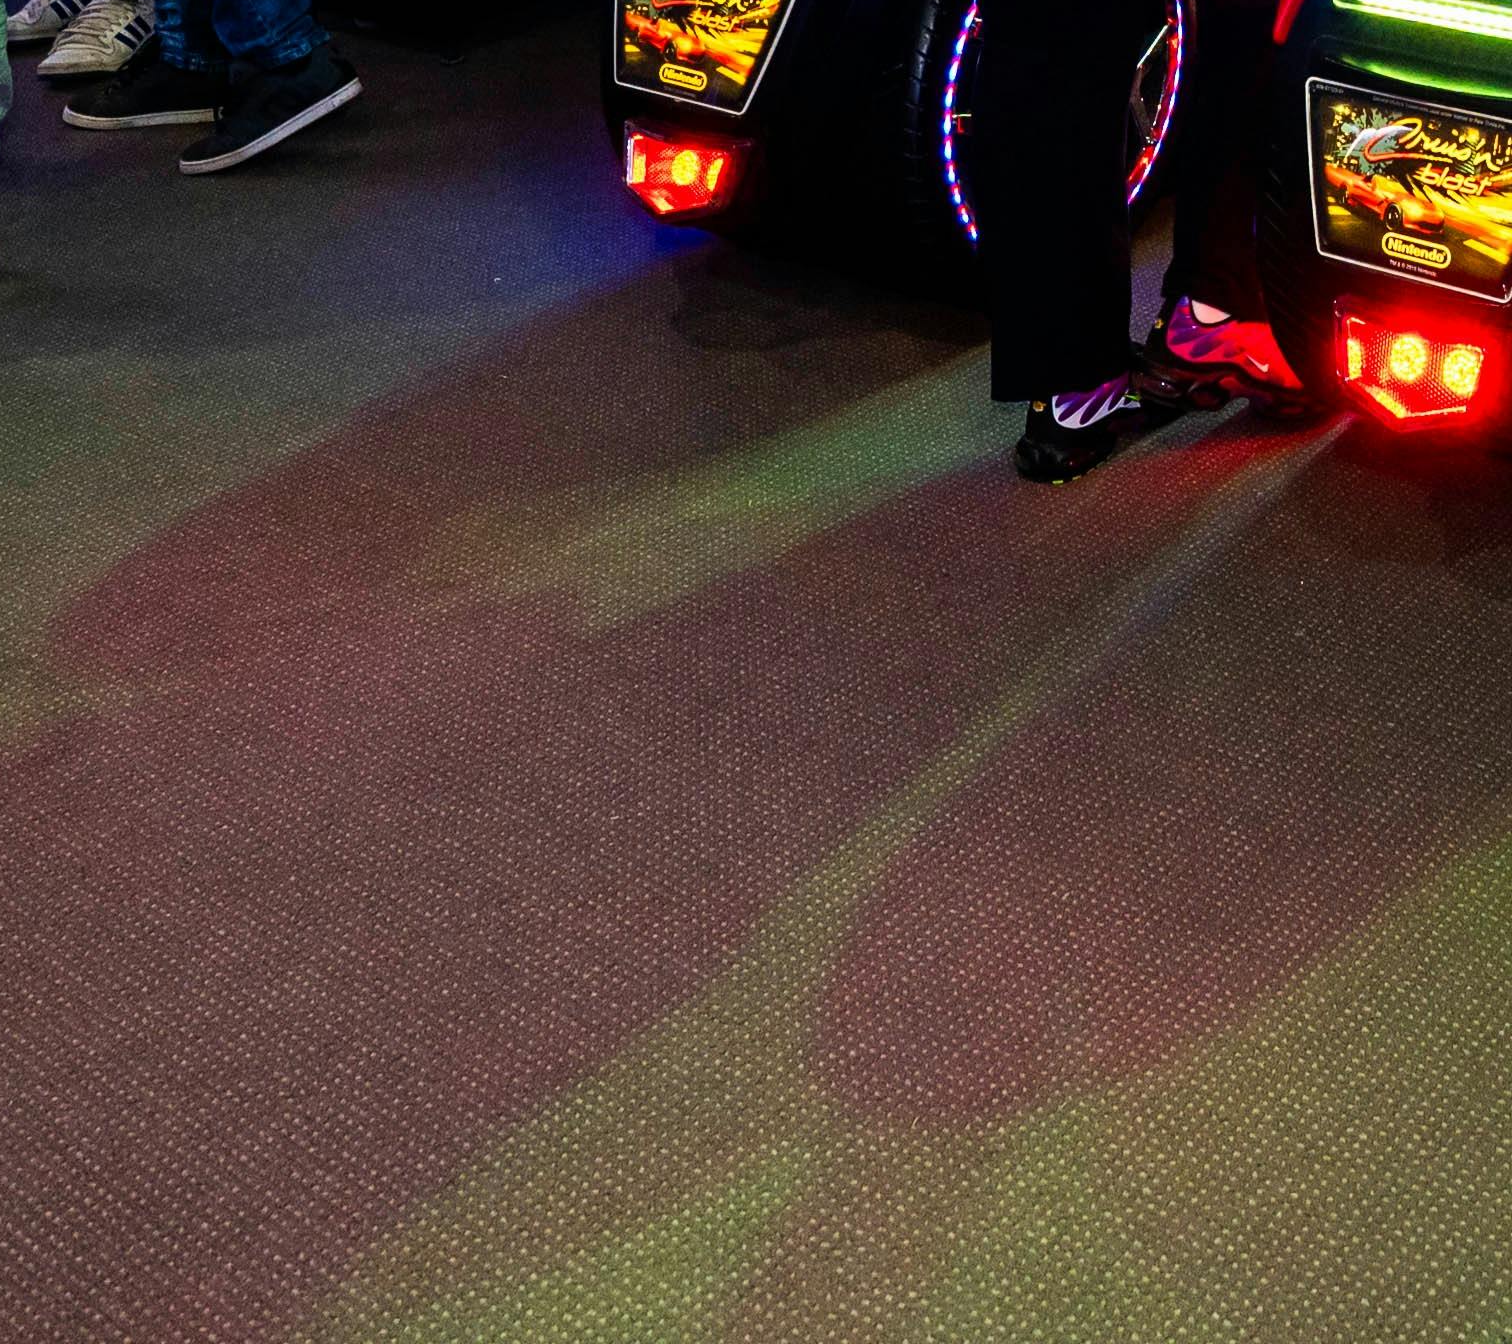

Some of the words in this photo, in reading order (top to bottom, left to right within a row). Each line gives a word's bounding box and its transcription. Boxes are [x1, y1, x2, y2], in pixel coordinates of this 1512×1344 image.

[689, 7, 740, 32] blast
[1418, 162, 1493, 196] blast
[1387, 237, 1445, 263] Nintendo
